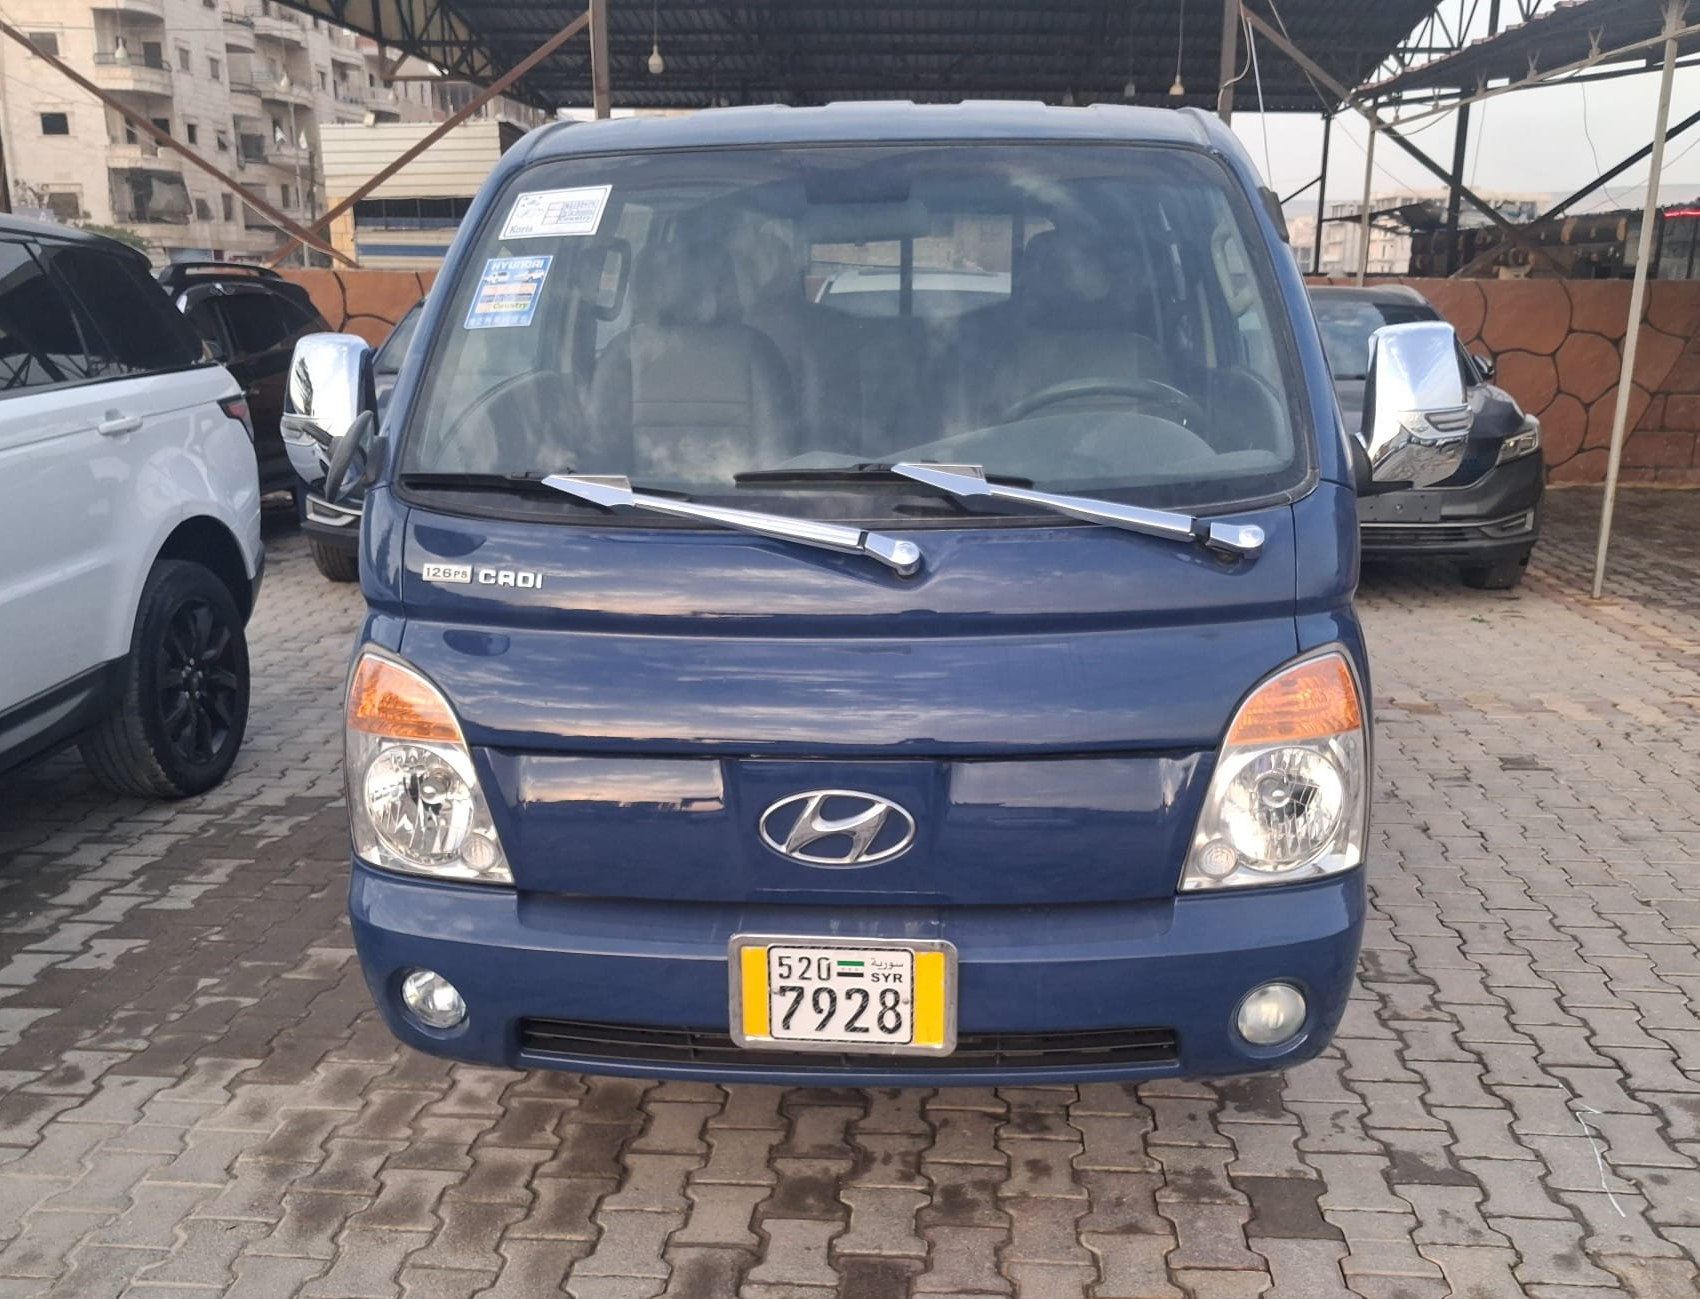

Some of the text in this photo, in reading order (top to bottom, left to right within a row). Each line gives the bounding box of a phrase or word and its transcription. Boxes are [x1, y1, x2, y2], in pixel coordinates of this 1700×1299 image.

[491, 260, 544, 271] HYUNDAI
[493, 302, 528, 311] Country
[426, 567, 468, 579] 126PS
[778, 955, 831, 982] 520
[871, 957, 904, 970] سورية
[871, 972, 904, 984] SYR
[778, 985, 903, 1035] 7928
